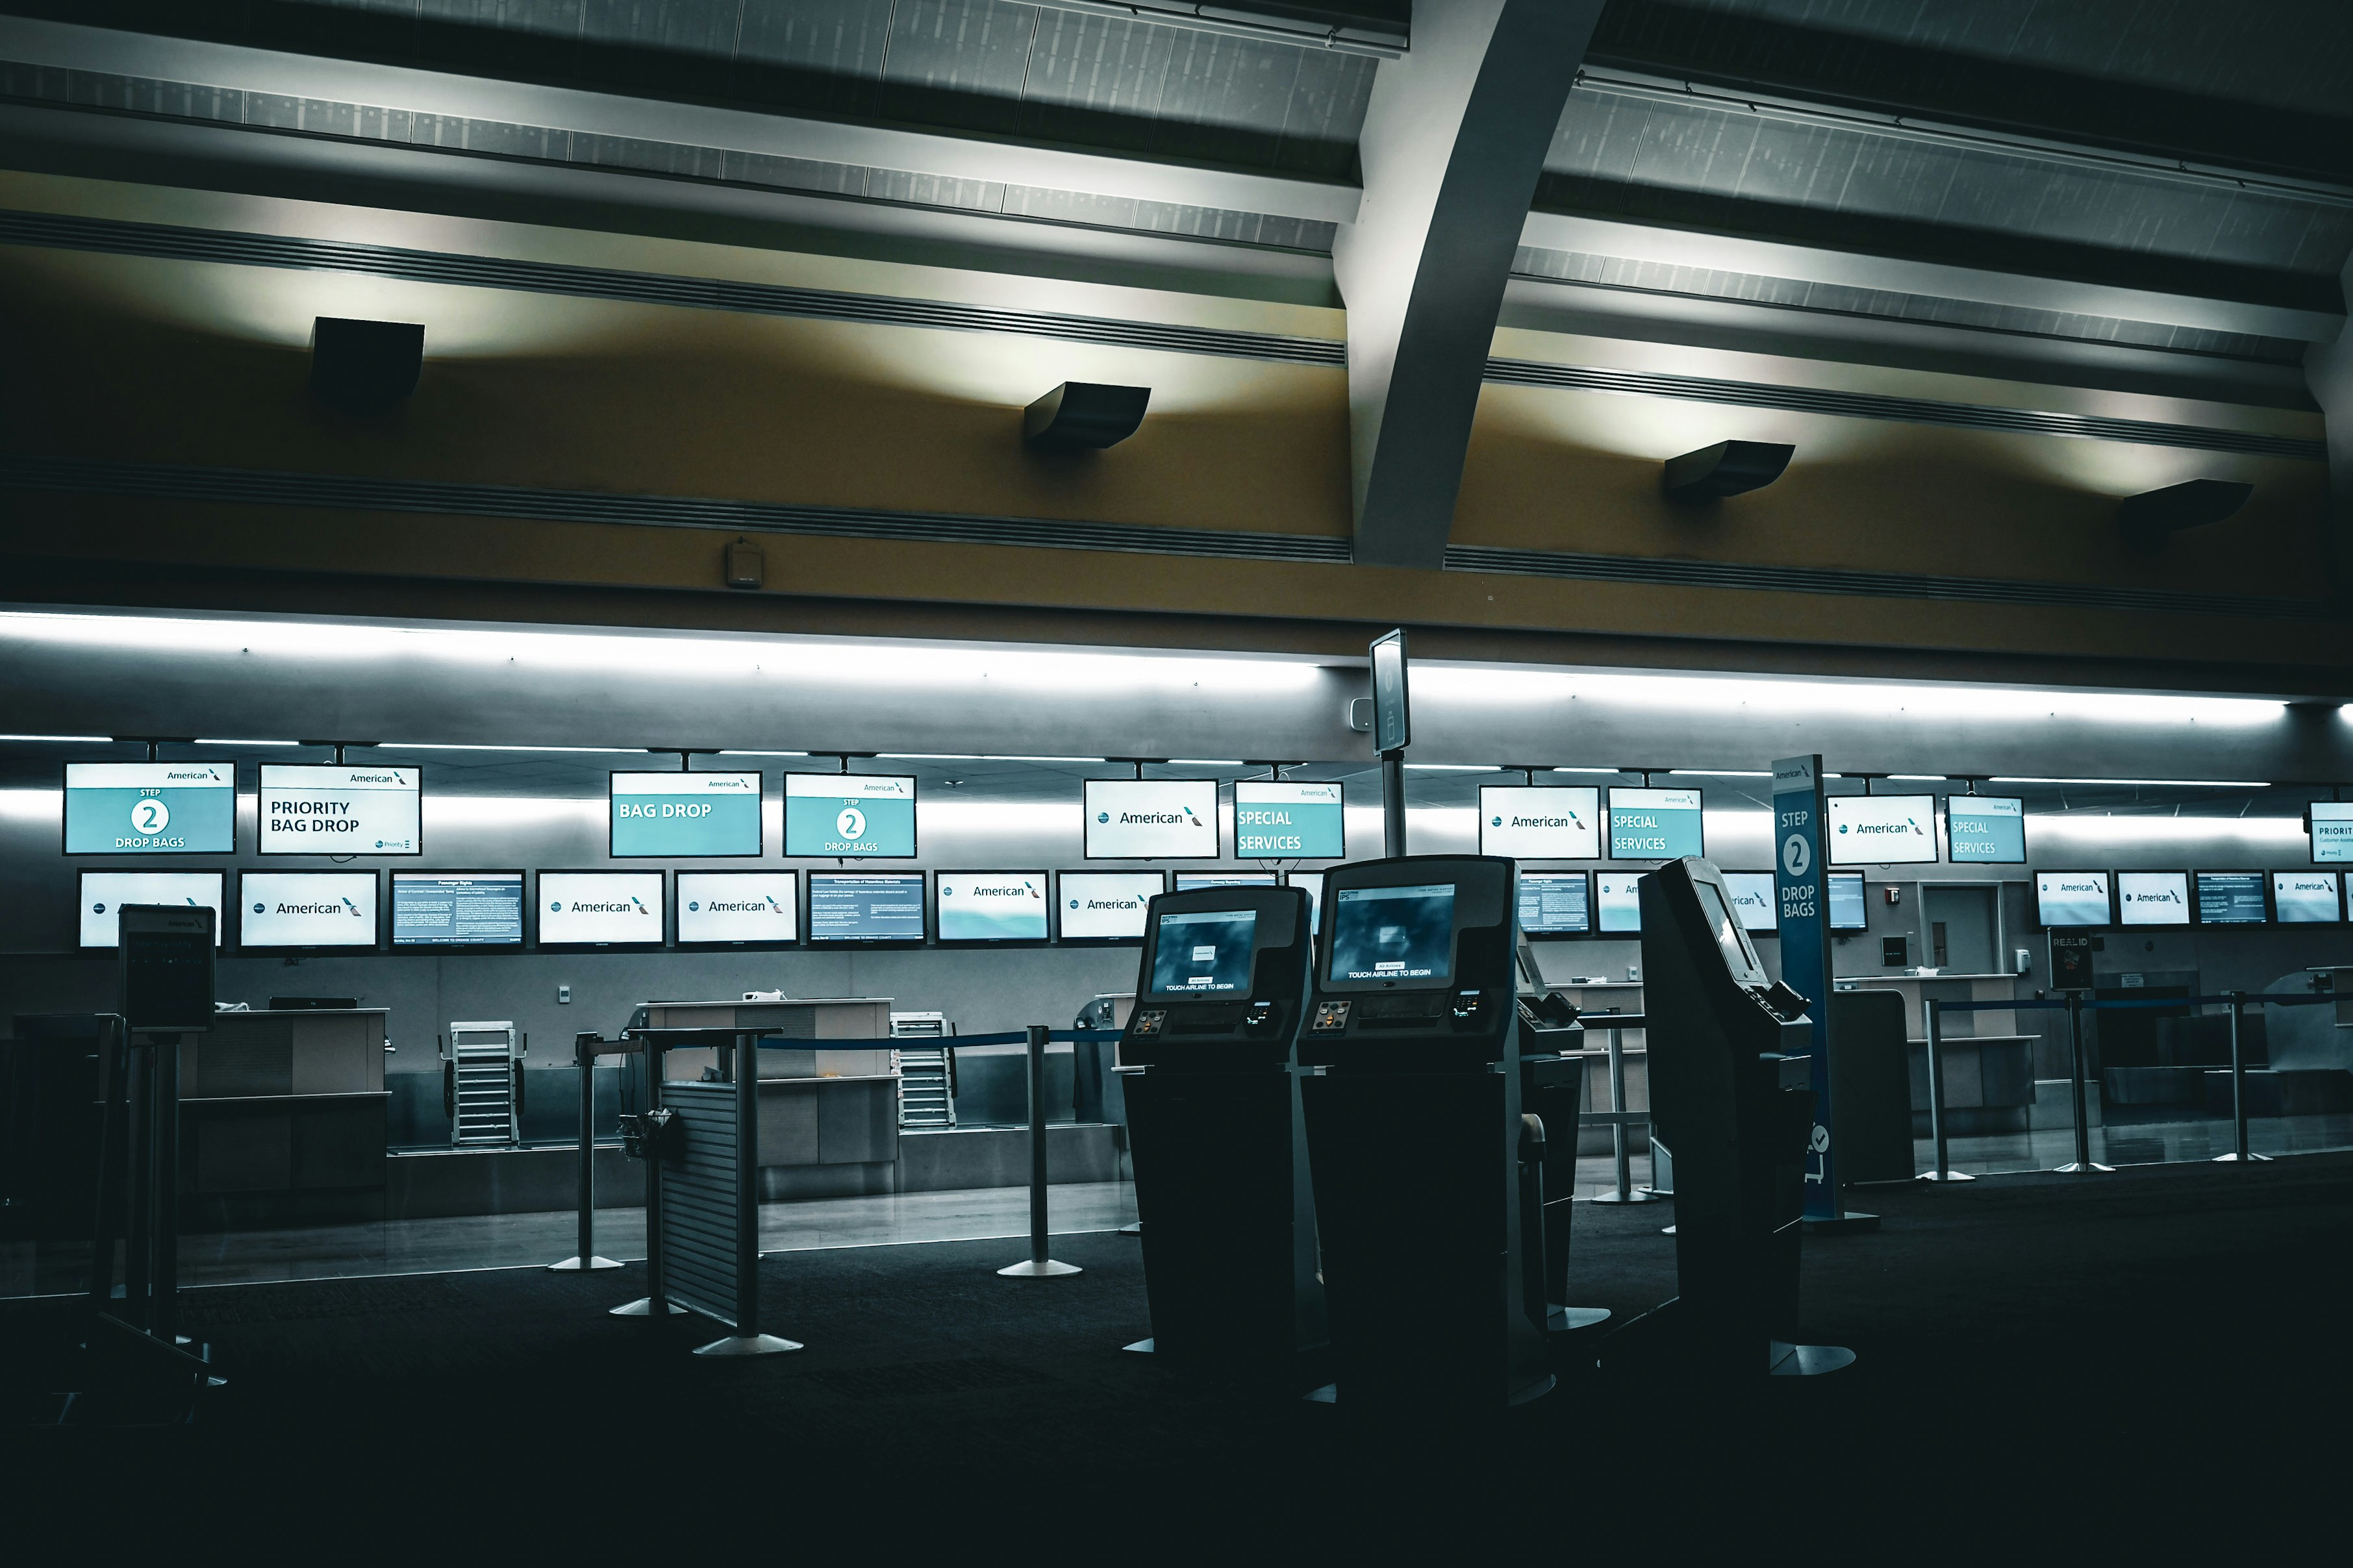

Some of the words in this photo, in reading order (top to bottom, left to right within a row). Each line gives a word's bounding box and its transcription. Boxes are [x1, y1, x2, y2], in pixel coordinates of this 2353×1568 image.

[1776, 769, 1801, 779] American
[271, 802, 350, 814] PRIORITY
[620, 804, 657, 818] BAG
[662, 803, 712, 817] DROP
[143, 806, 157, 828] 2
[1120, 812, 1182, 823] American
[1239, 811, 1292, 825] SPECIAL
[1511, 816, 1568, 827] American
[1614, 815, 1658, 828] SPECIAL
[1781, 811, 1808, 828] STEP
[271, 820, 306, 832] BAG
[312, 820, 359, 832] DROP
[846, 814, 857, 834] 2
[1857, 823, 1907, 834] American
[1954, 821, 1988, 834] SPECIAL
[116, 838, 150, 848] DROP
[153, 838, 184, 847] BAGS
[824, 842, 851, 851] DROP
[853, 843, 878, 852] BAGS
[1239, 836, 1302, 850] SERVICES
[1615, 838, 1666, 850] SERVICES
[1954, 842, 1996, 854] SERVICES
[1791, 841, 1803, 867] 2
[974, 886, 1024, 896] American
[1782, 885, 1815, 901] DROP
[1731, 896, 1754, 905] rican
[2137, 893, 2171, 902] American
[276, 903, 341, 914] American
[572, 901, 630, 912] American
[709, 901, 764, 912] American
[1087, 899, 1137, 909] American
[1784, 902, 1815, 917] BAGS
